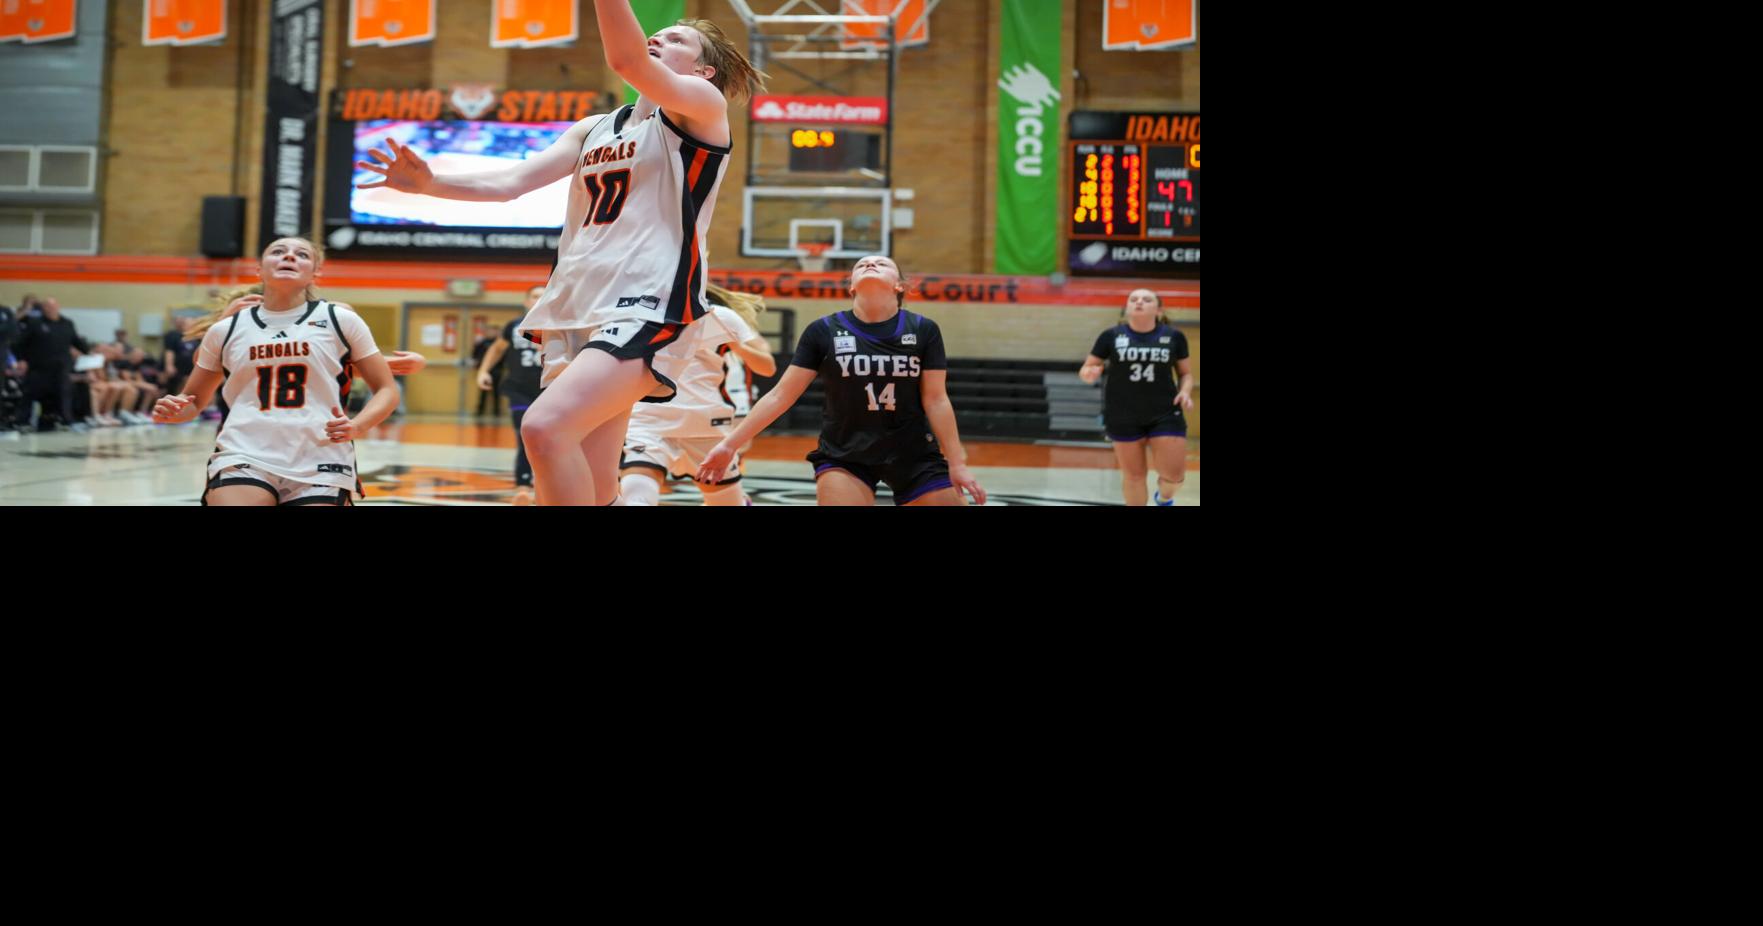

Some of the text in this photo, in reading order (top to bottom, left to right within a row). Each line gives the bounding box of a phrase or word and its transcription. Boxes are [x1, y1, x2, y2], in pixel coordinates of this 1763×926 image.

[342, 88, 595, 121] IDAHO STATE
[1125, 115, 1200, 141] IDAHO
[1155, 168, 1189, 180] HOME
[583, 167, 632, 228] 10
[1157, 179, 1192, 203] 47
[357, 231, 411, 247] IDAHO
[412, 232, 485, 248] CENTRAL
[486, 233, 544, 249] CREDIT
[1112, 248, 1200, 262] IDAHO CE
[919, 276, 1018, 303] Court
[250, 341, 310, 361] BENGALS
[1117, 347, 1170, 362] YOTES
[835, 354, 921, 378] YOTES
[1129, 363, 1155, 382] 34
[256, 363, 308, 411] 18
[864, 382, 897, 411] 14
